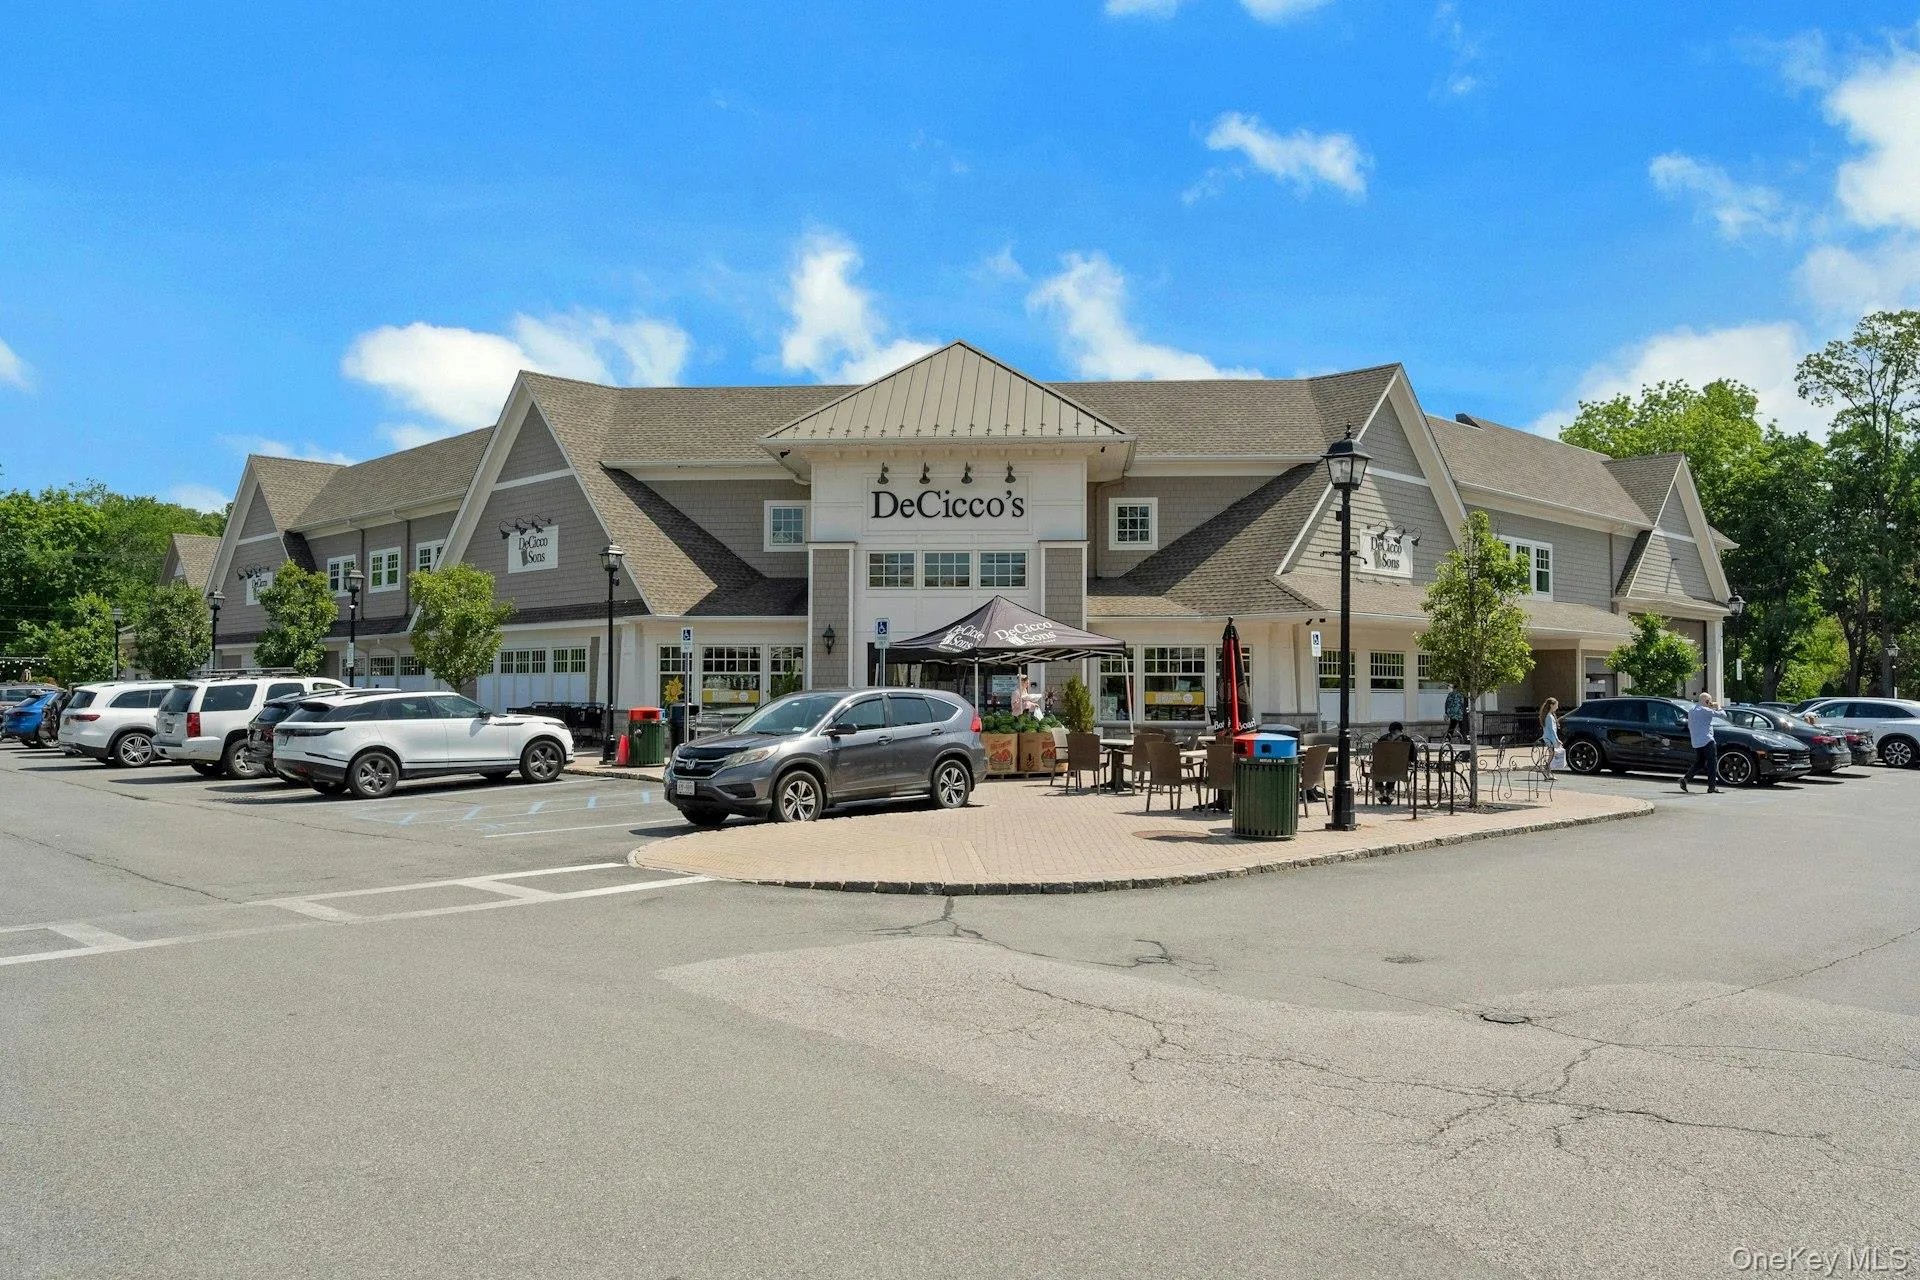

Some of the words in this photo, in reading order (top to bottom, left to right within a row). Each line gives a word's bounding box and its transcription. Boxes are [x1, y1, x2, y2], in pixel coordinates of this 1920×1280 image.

[871, 490, 1025, 519] DeCicco's
[518, 535, 549, 550] DeCicco
[1370, 536, 1403, 554] DeCicco
[528, 550, 546, 564] Sons
[1382, 553, 1400, 569] Sons
[993, 621, 1053, 641] DeCicco
[1021, 631, 1057, 643] Sons
[950, 635, 974, 650] Sons
